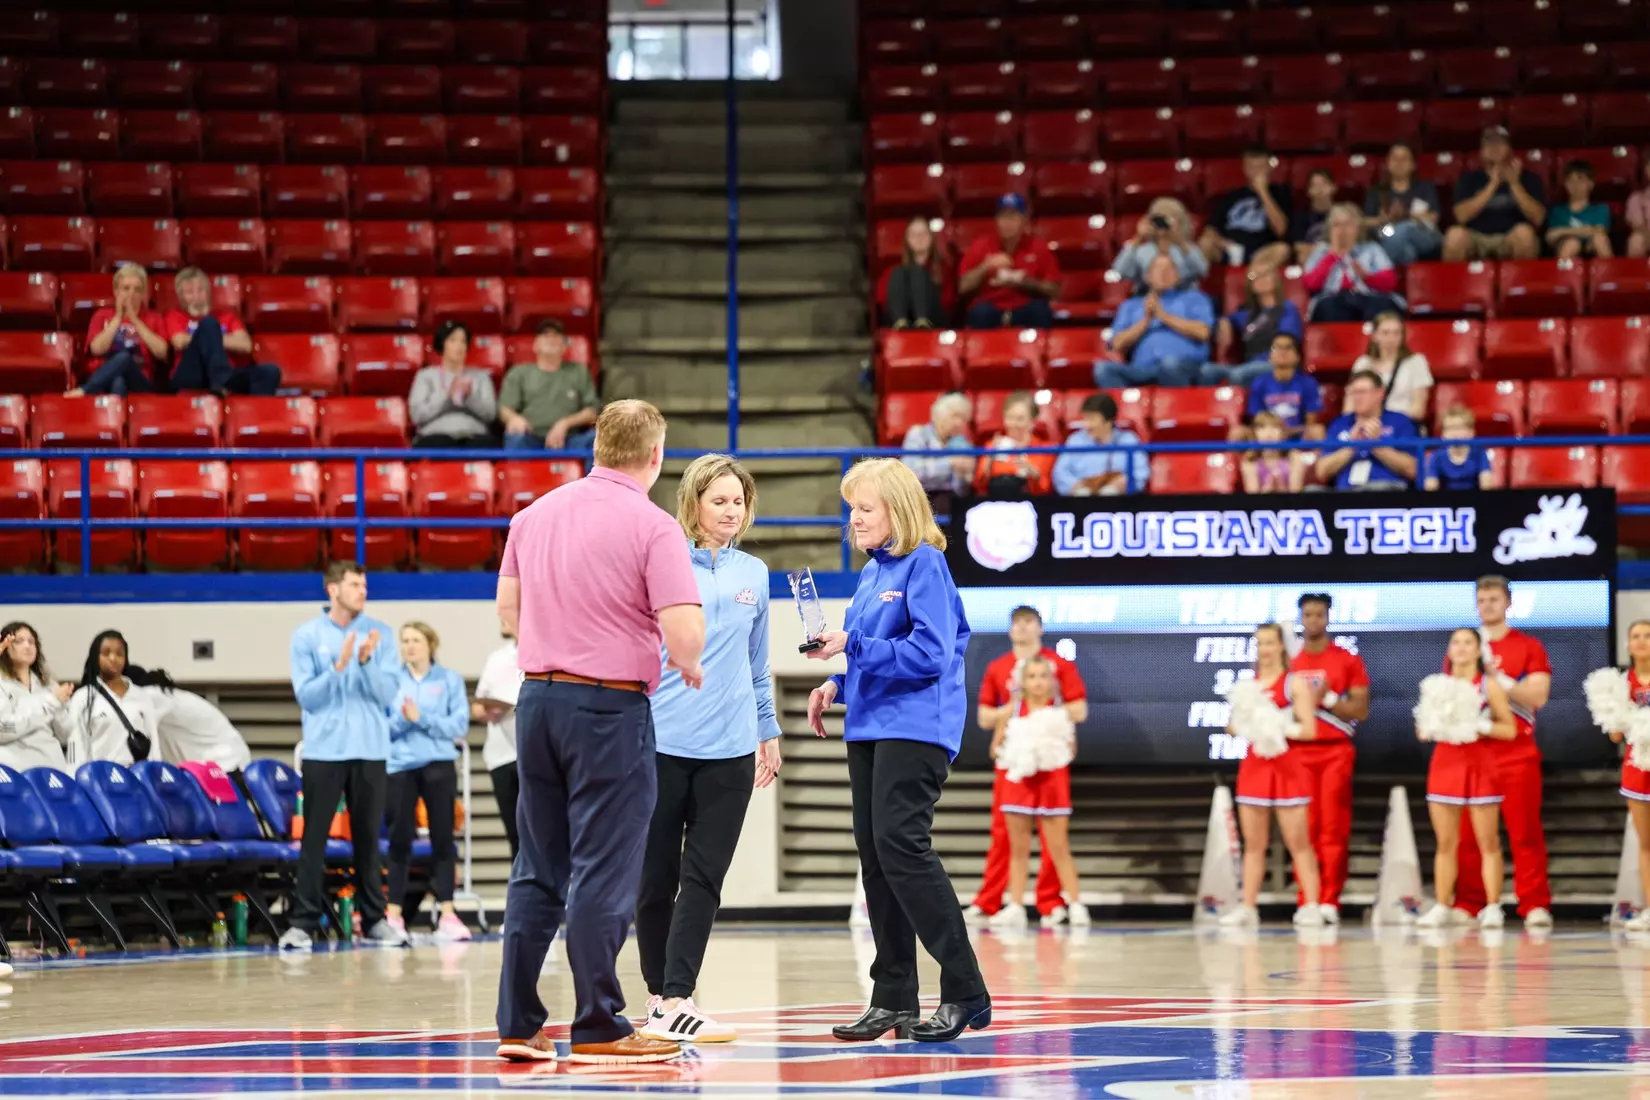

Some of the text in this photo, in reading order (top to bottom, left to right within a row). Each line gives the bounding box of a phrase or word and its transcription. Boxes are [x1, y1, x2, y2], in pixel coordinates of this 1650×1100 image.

[1051, 510, 1332, 558] LOUISIANA
[1334, 507, 1477, 555] TECH
[1178, 589, 1377, 623] TEAM STS
